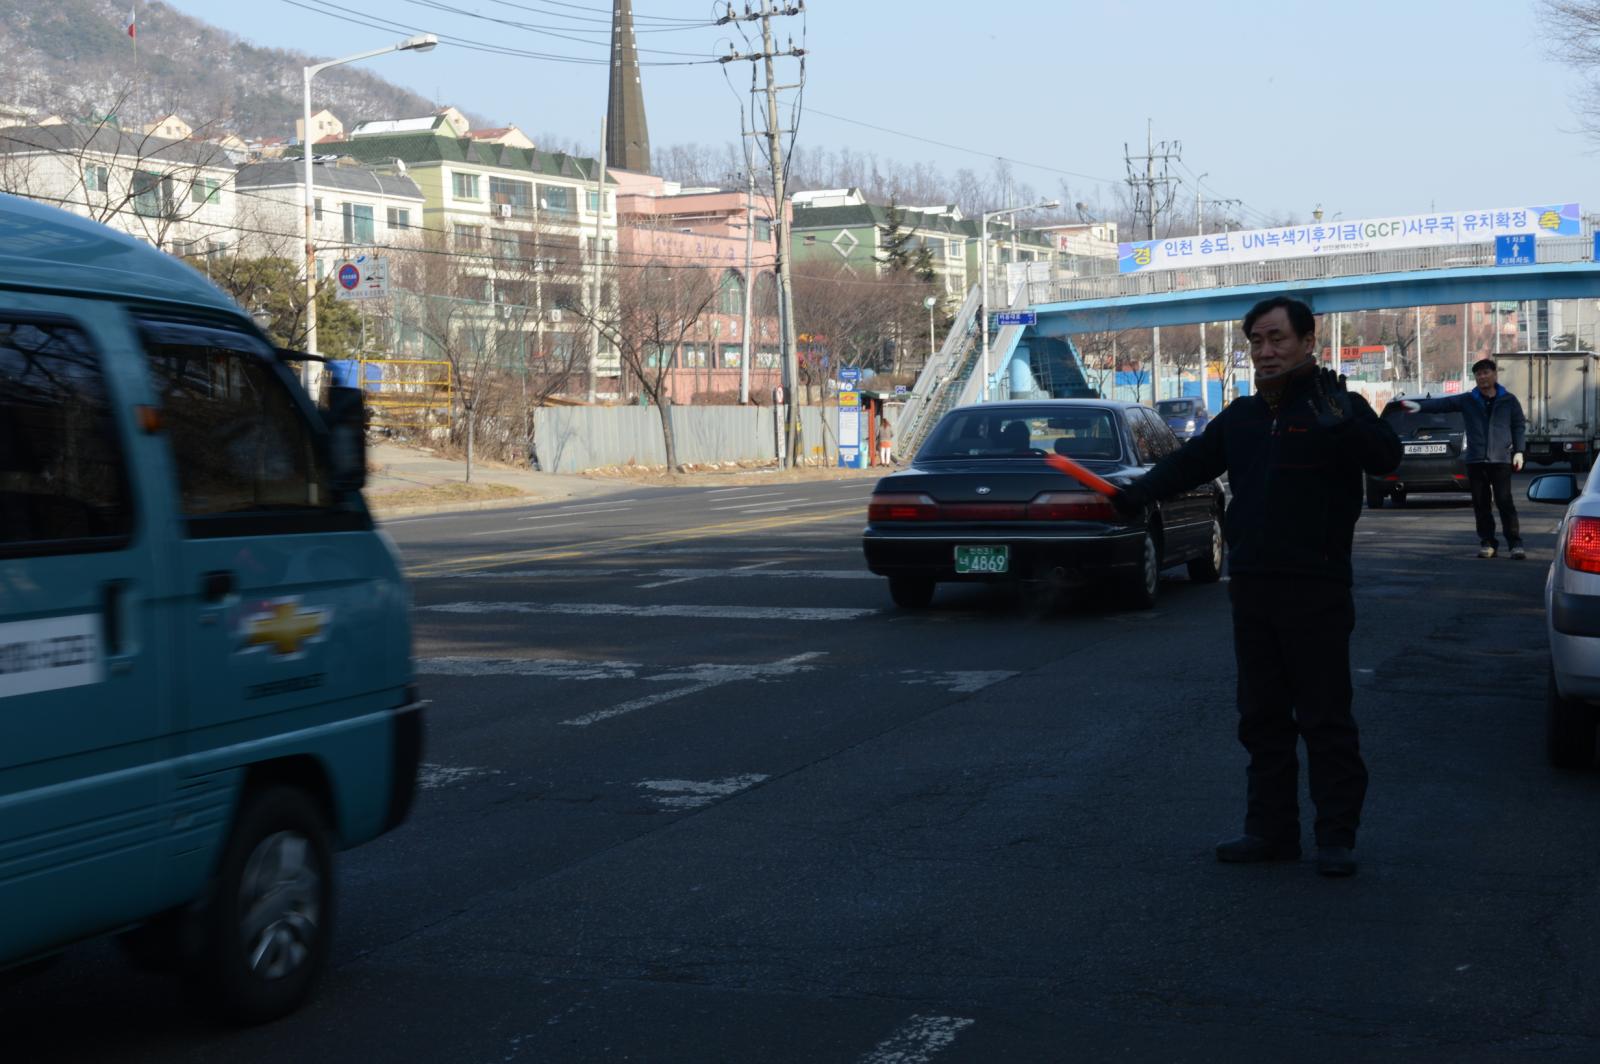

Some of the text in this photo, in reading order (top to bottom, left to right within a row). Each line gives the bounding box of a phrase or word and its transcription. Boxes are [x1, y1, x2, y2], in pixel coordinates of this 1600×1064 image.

[1538, 210, 1561, 231] 축
[1164, 240, 1193, 257] 인천
[1200, 236, 1234, 255] 송도,
[1463, 210, 1527, 232] 유치확정
[1134, 246, 1152, 265] 경
[971, 555, 1005, 571] 4869
